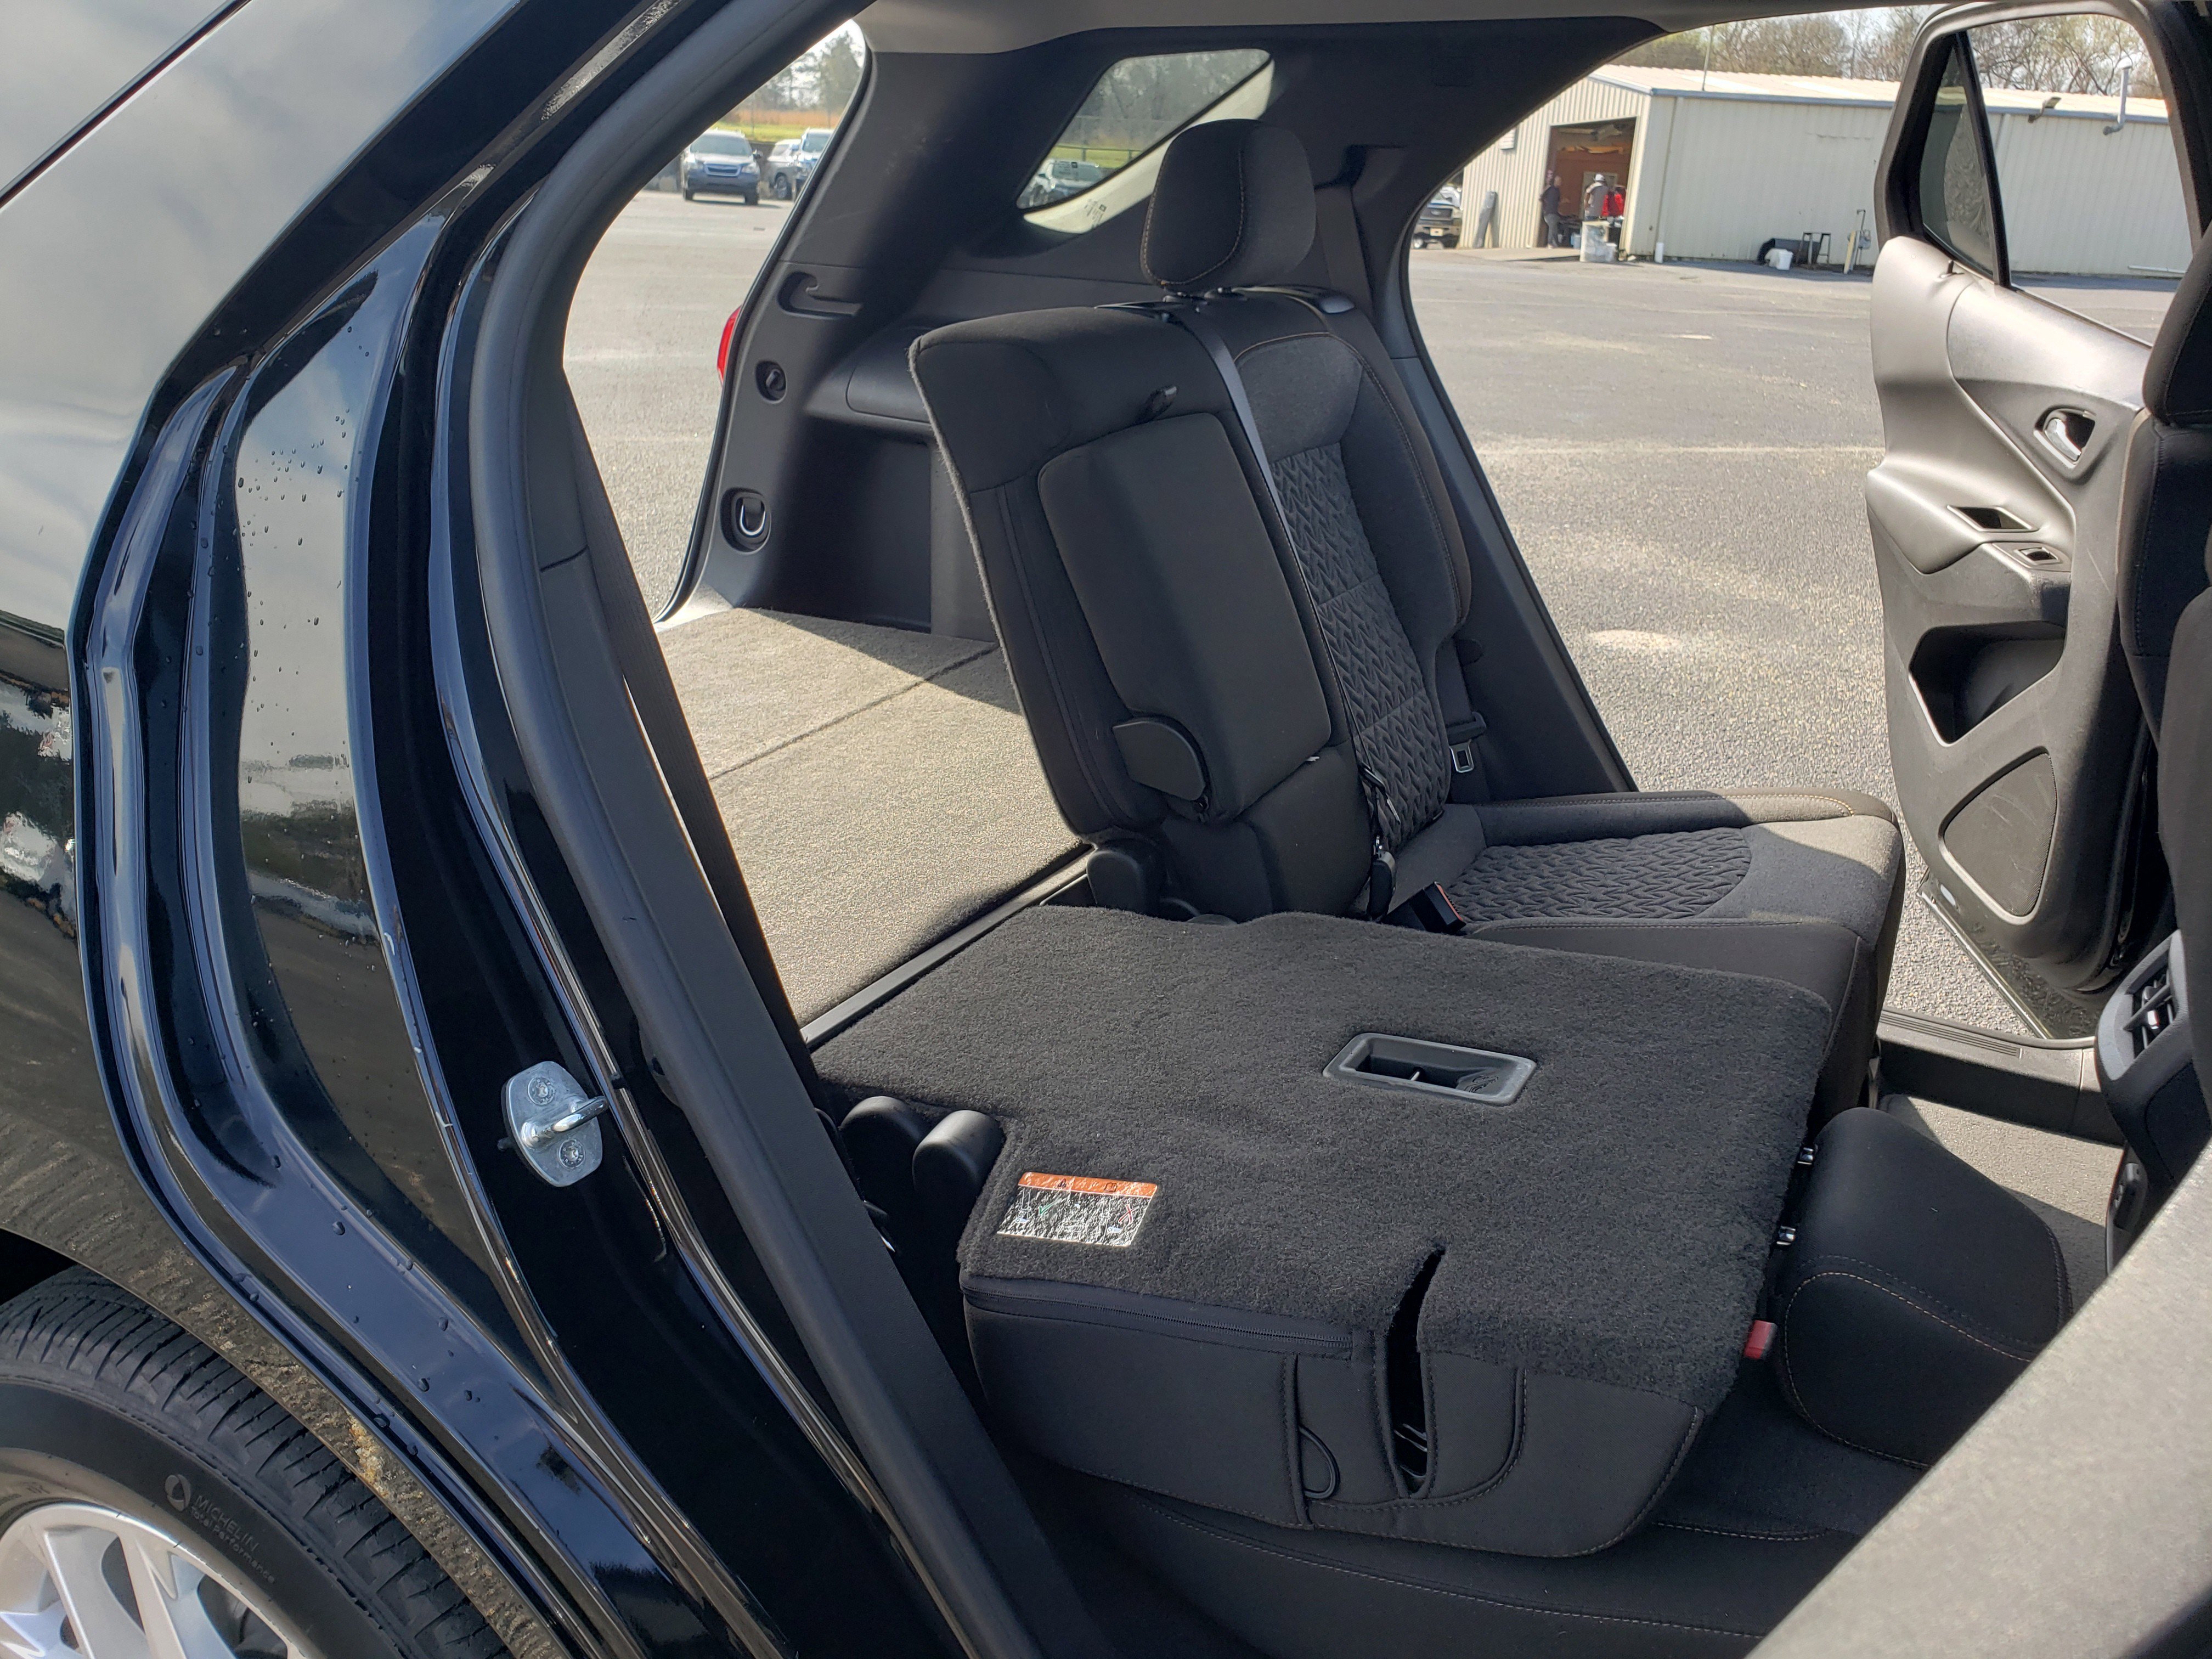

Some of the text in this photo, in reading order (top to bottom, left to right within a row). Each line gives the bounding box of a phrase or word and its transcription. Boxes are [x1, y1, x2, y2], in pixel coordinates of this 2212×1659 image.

[190, 1506, 275, 1583] Total Performance
[195, 1496, 259, 1551] MICHELIN
